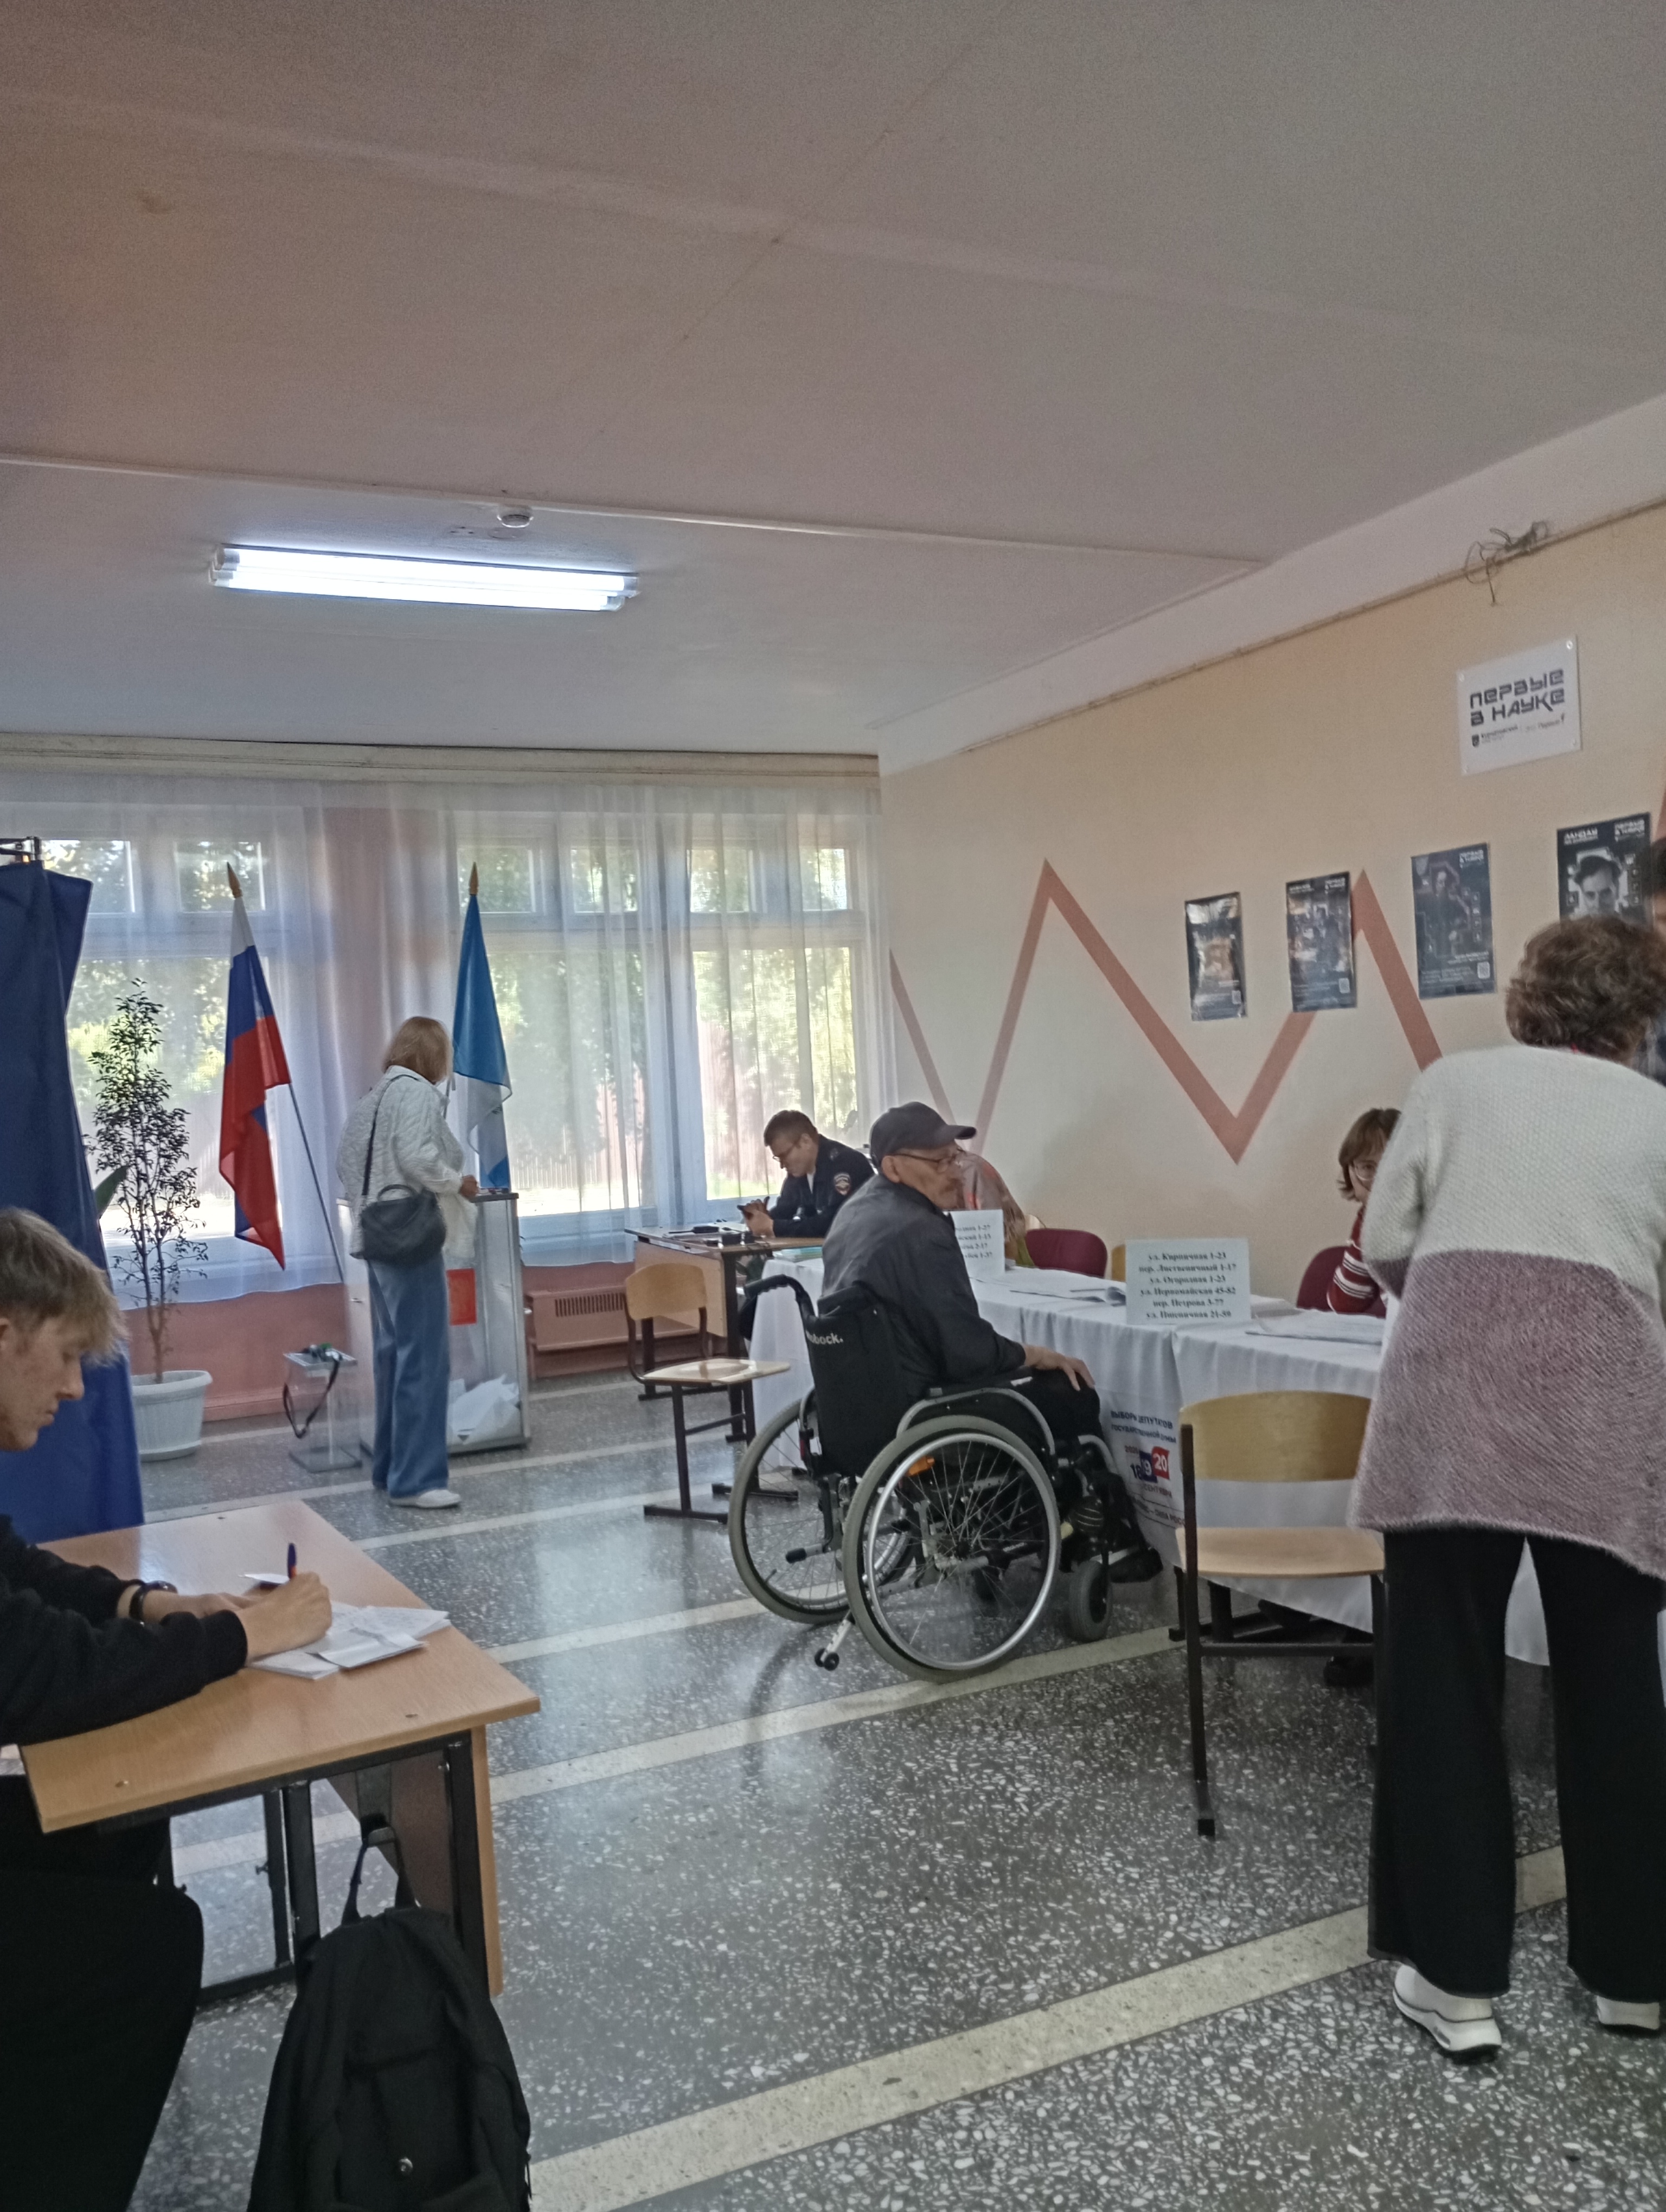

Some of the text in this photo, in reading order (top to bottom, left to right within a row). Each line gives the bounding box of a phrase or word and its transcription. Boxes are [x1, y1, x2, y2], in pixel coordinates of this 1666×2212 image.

[1470, 669, 1564, 709] ПЕРВЫЕ
[1471, 688, 1565, 727] В НАУКЕ
[1153, 1452, 1168, 1473] 20
